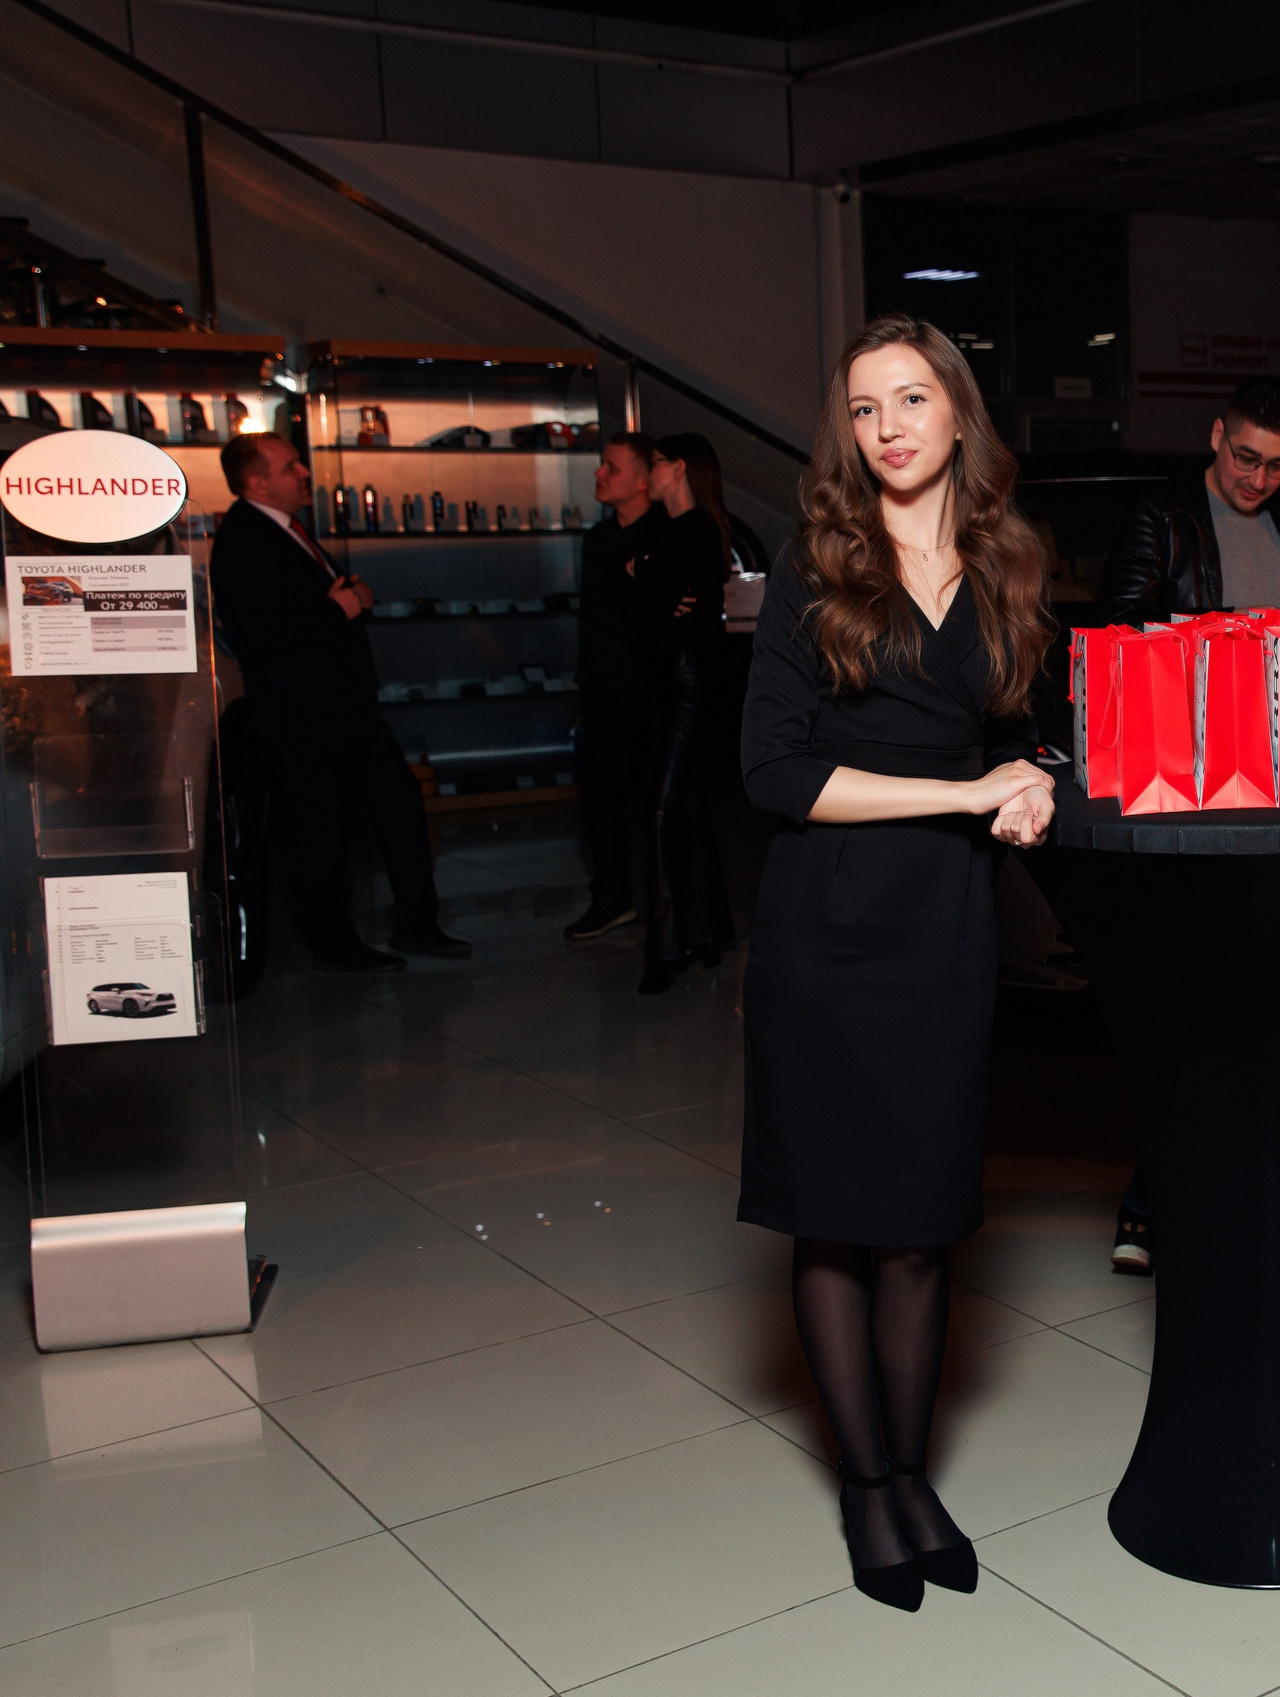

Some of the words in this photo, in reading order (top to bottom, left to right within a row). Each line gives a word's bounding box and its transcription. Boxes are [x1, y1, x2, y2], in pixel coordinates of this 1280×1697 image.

[5, 477, 182, 496] HIGHLANDER
[18, 565, 65, 575] TOYOTA
[68, 564, 147, 574] HIGHLANDER
[86, 592, 126, 600] Платеж
[127, 592, 142, 600] по
[143, 591, 187, 601] кредиту
[100, 601, 116, 610] От
[119, 601, 134, 610] 29
[136, 600, 158, 610] 400
